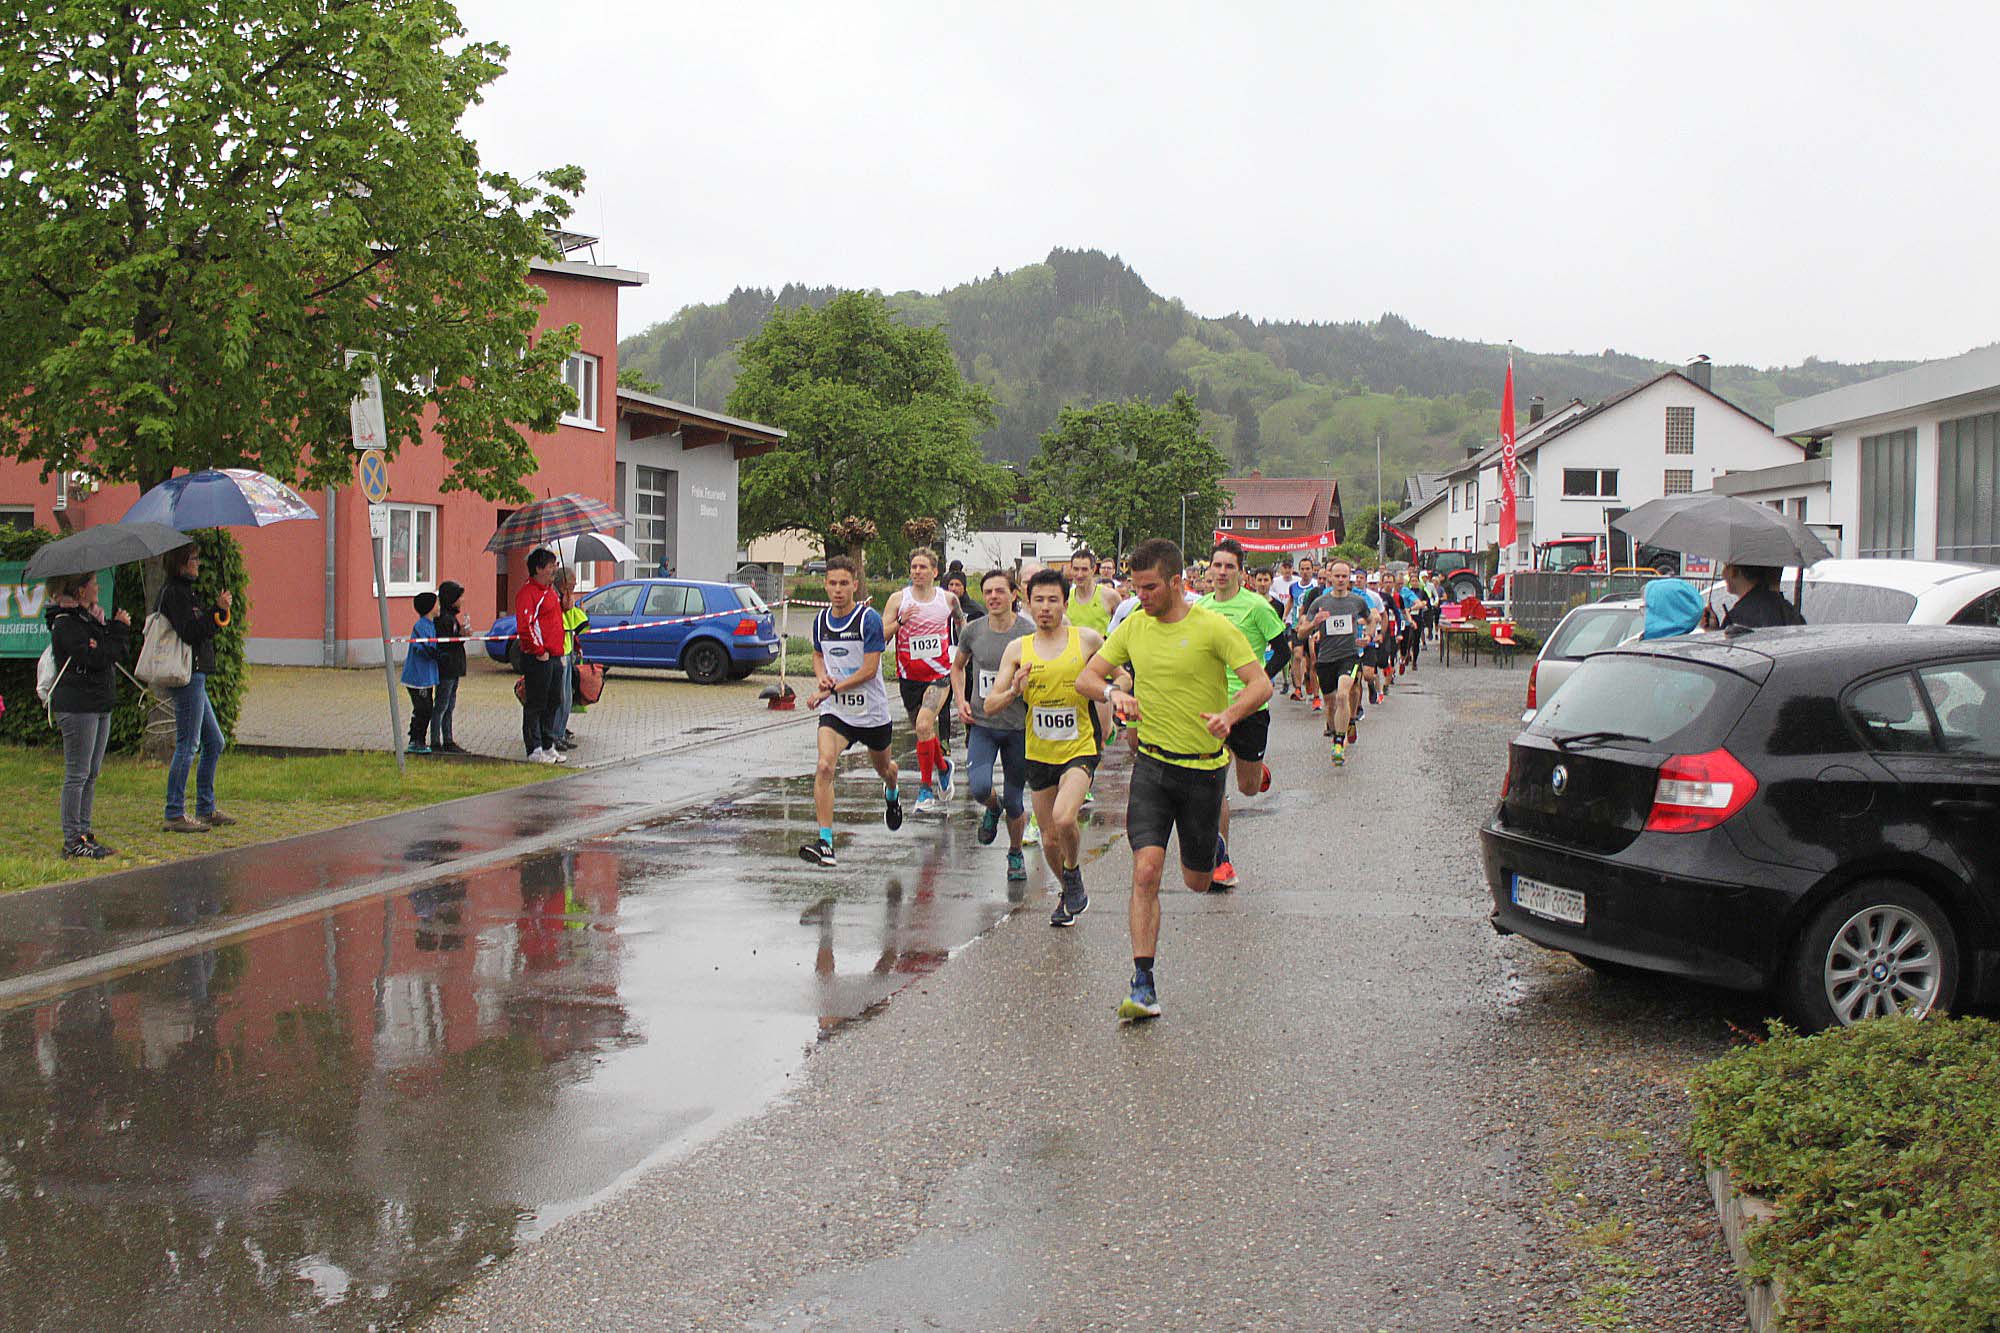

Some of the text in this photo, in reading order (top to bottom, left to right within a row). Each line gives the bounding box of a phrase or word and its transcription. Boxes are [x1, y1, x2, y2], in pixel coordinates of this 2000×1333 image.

[1333, 619, 1345, 628] 65
[912, 638, 939, 651] 1032
[834, 691, 865, 706] 1159
[1036, 713, 1075, 729] 1066
